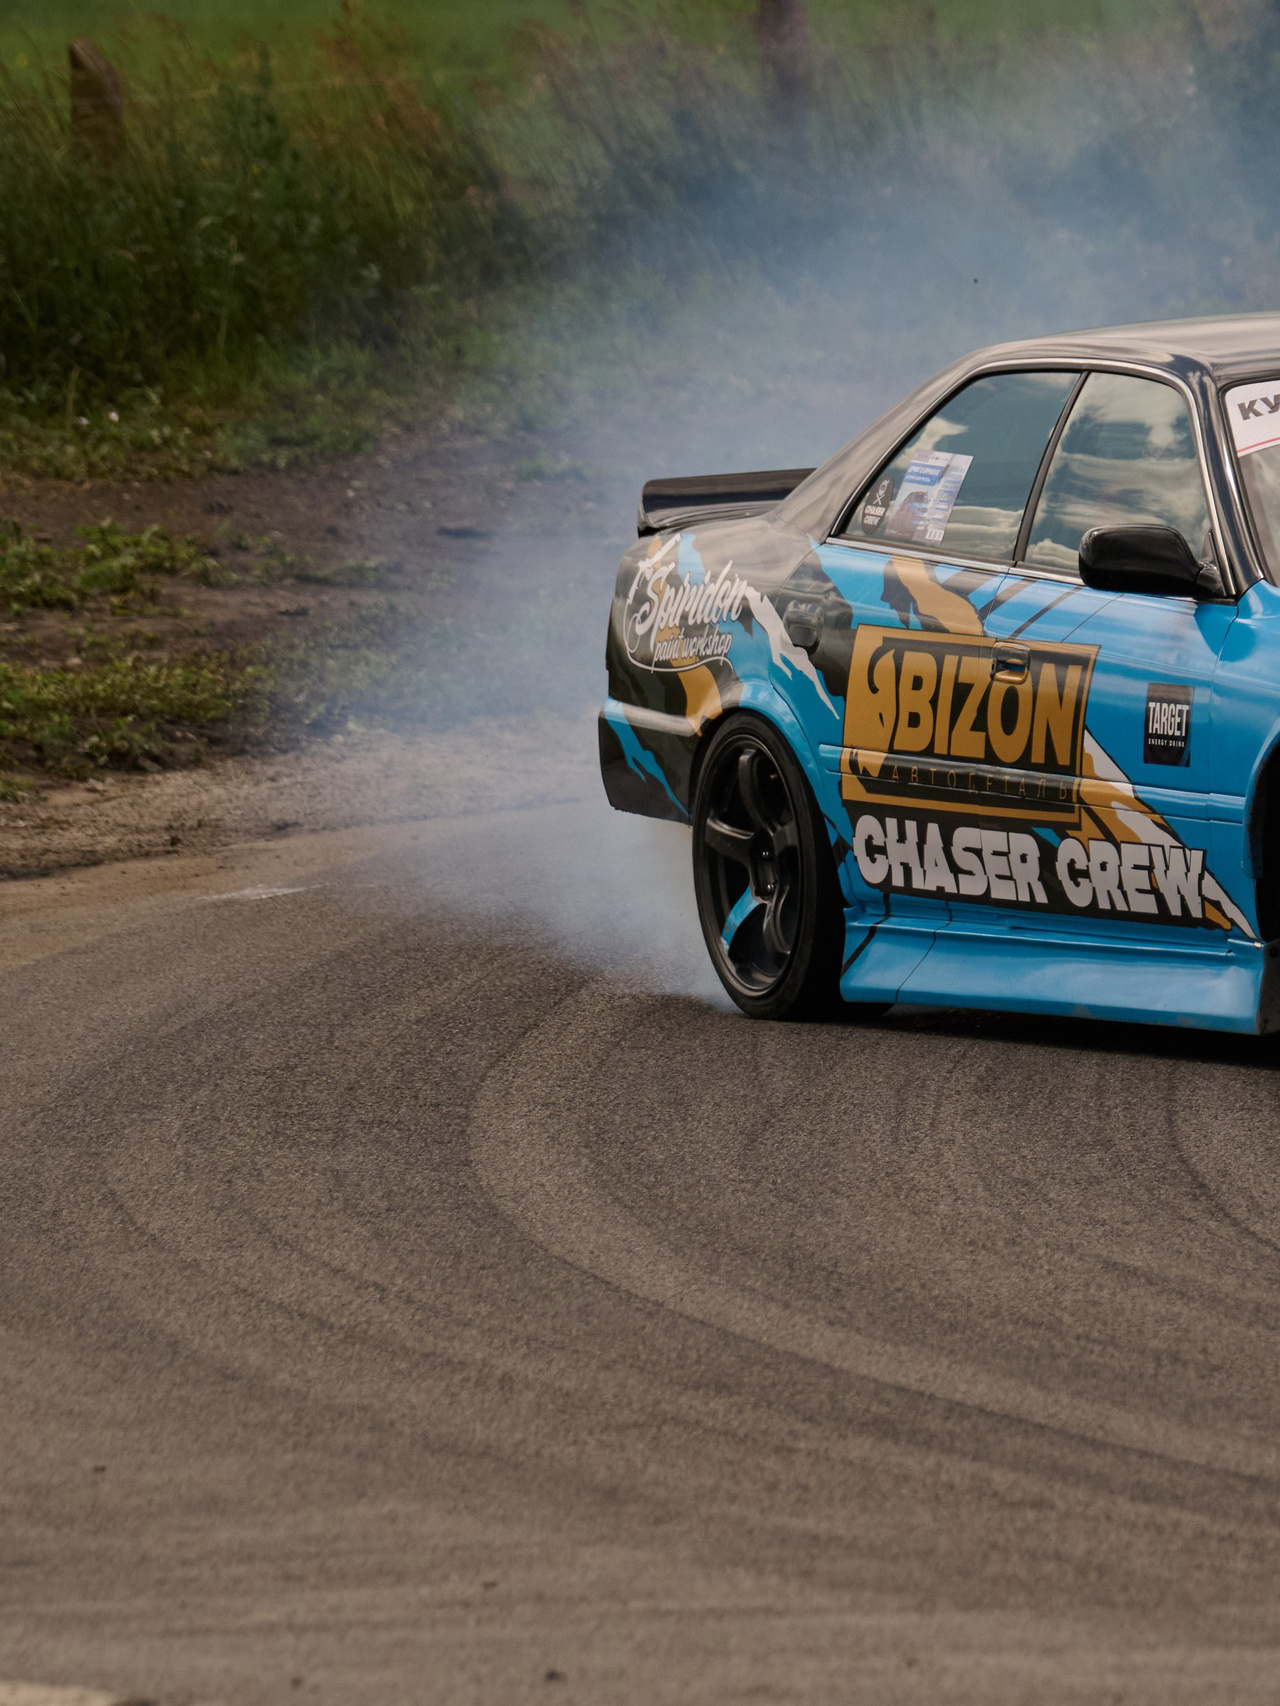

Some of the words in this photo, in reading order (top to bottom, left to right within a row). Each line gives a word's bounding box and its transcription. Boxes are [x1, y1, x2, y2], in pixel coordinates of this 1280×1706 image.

[893, 650, 1083, 766] BIZON
[1148, 701, 1190, 737] TARGET
[1148, 738, 1167, 746] ENERGY
[1169, 740, 1185, 748] DRINK
[892, 765, 1067, 800] АВТОДЕТАЛЬ
[853, 814, 1049, 903] CHASER
[1055, 837, 1205, 919] CREW
